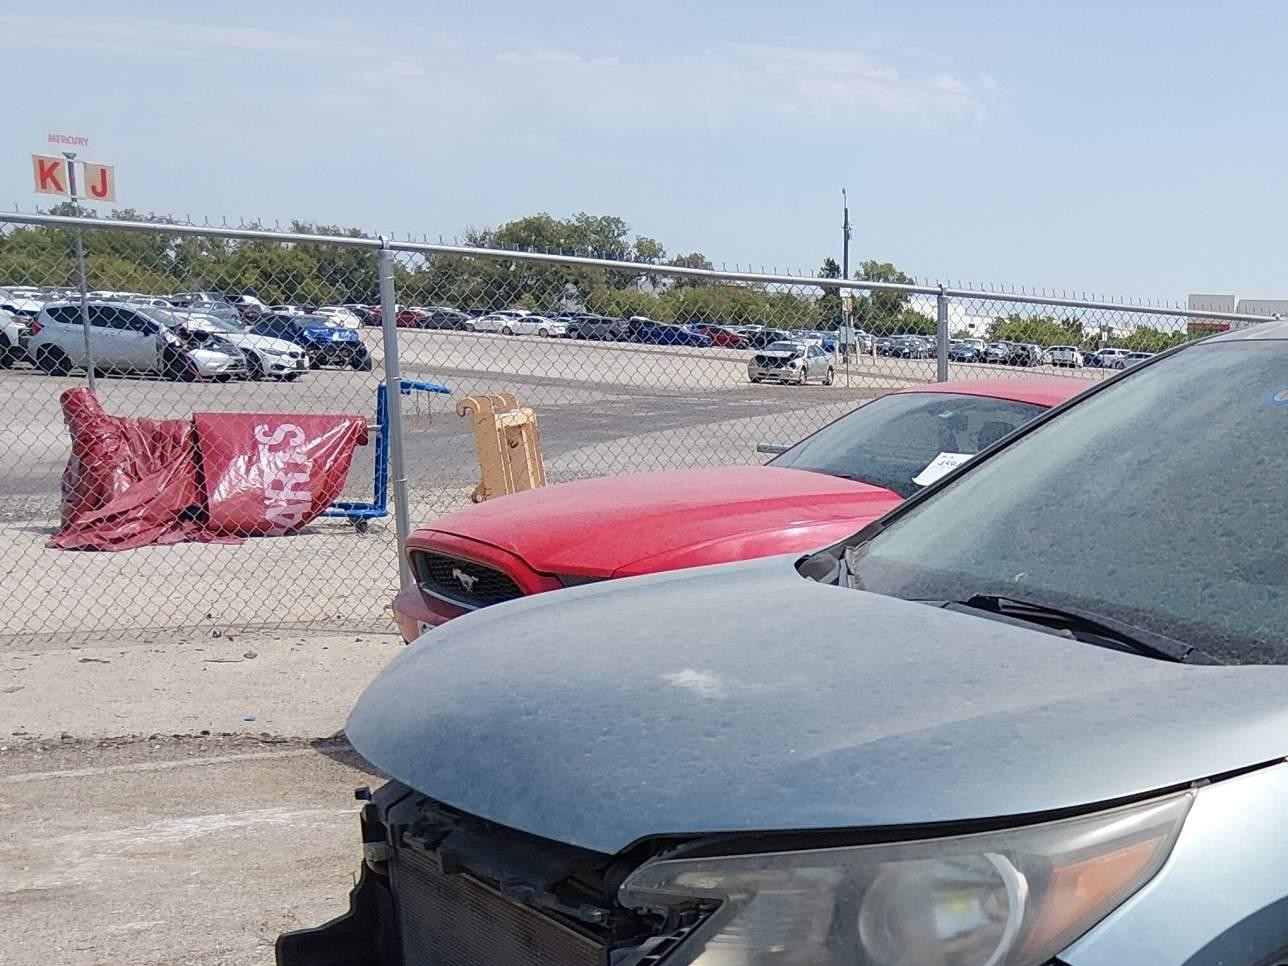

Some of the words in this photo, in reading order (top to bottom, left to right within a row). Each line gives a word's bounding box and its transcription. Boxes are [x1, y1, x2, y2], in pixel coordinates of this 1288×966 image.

[48, 134, 89, 147] MERCURY
[38, 159, 64, 192] K
[91, 168, 107, 197] J
